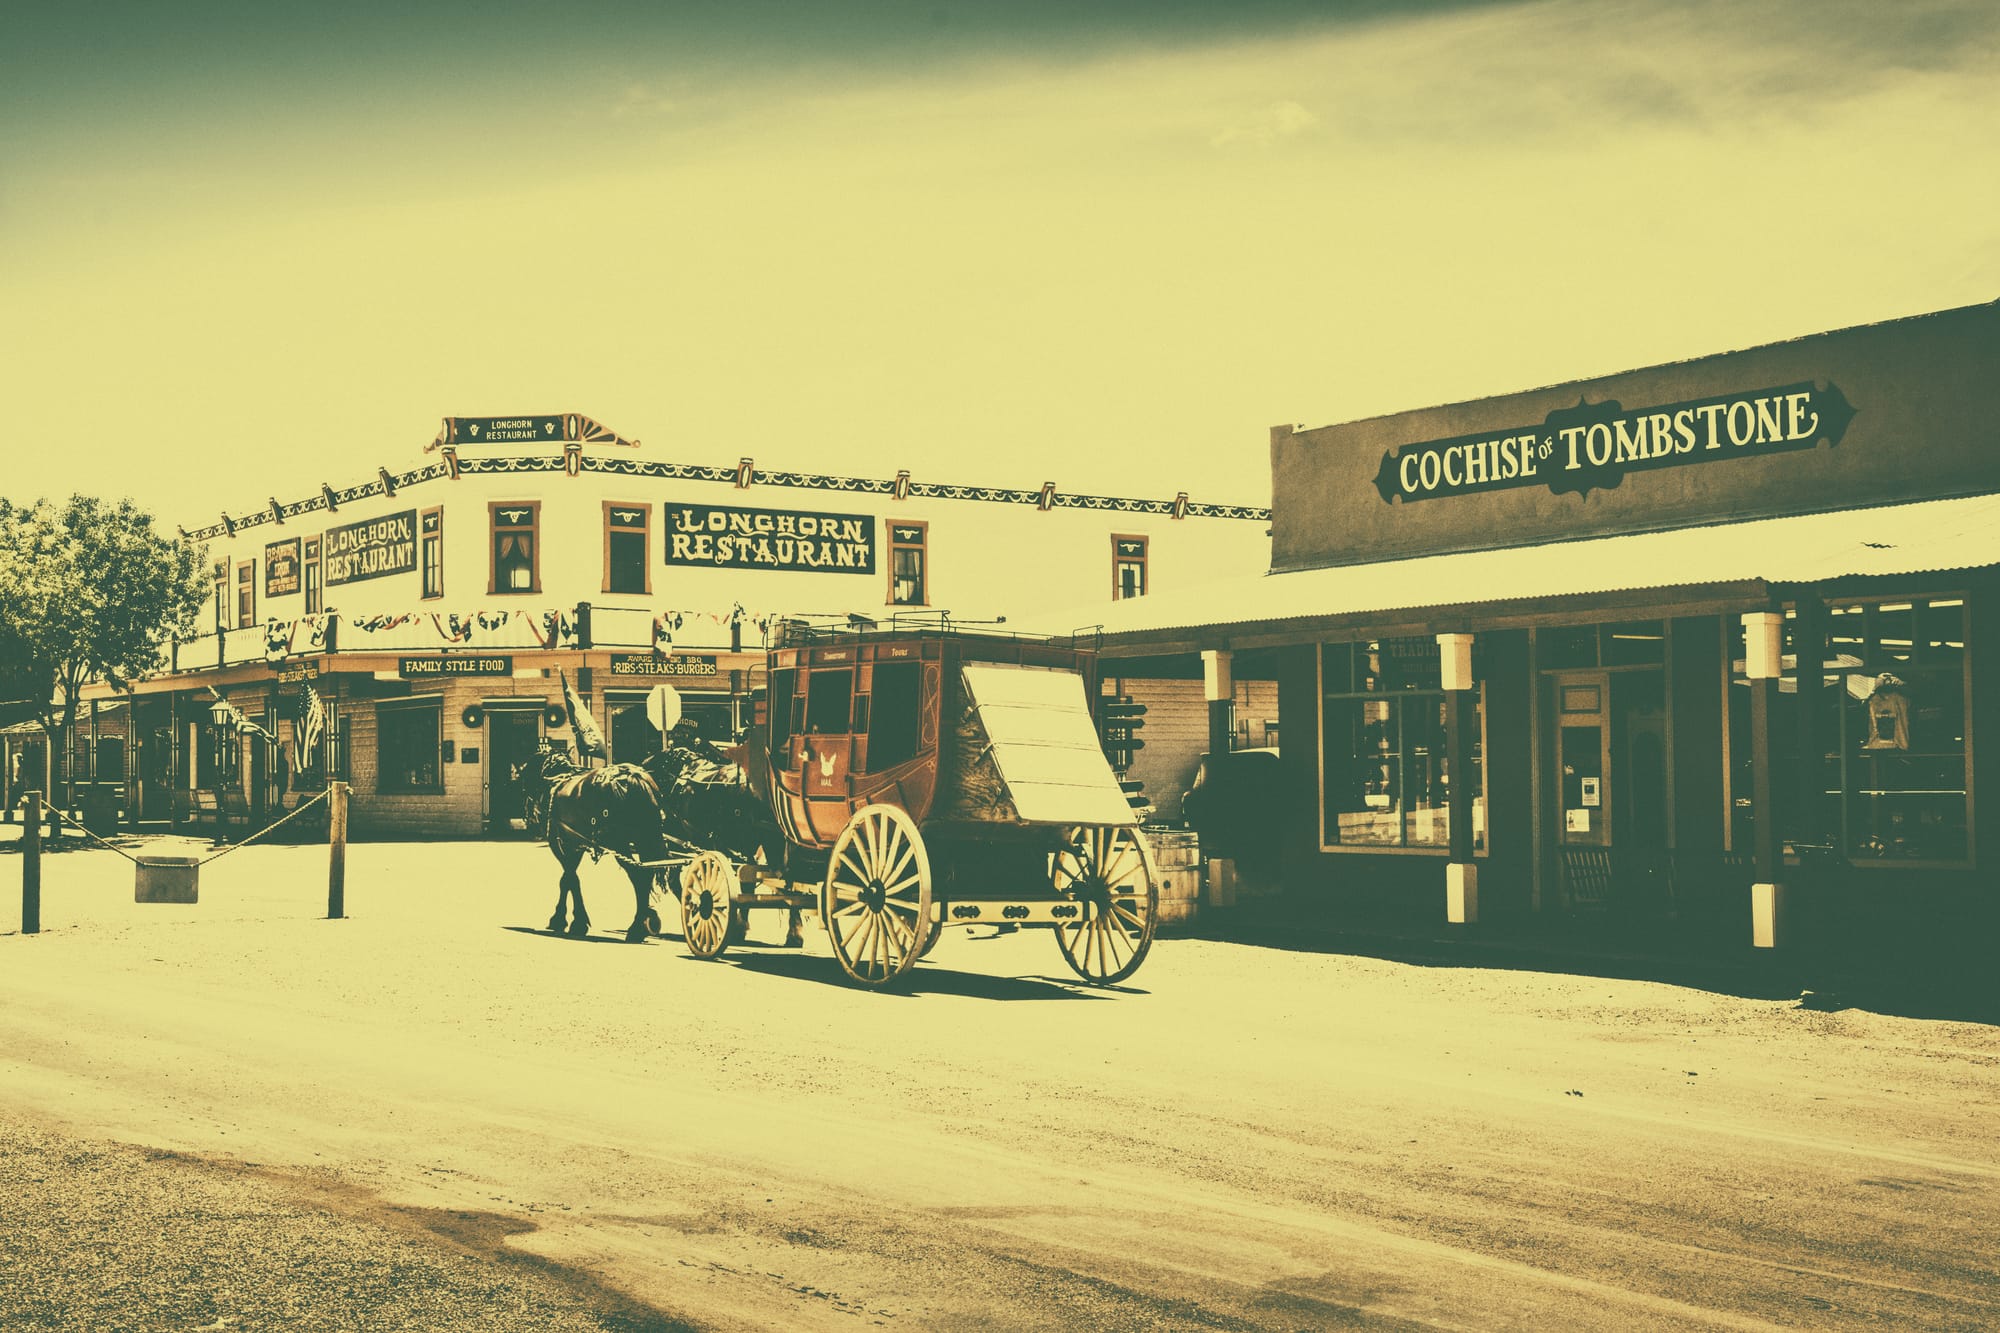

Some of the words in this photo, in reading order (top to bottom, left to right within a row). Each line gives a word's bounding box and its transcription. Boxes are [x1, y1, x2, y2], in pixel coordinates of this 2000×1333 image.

[486, 430, 537, 440] RESTAURANT
[491, 420, 532, 430] LONGHORN
[1400, 435, 1537, 493] COCHISE
[1538, 436, 1553, 460] OF
[1559, 392, 1819, 470] TOMBSTONE
[328, 517, 411, 556] LONGHORN
[676, 509, 867, 544] LONGHORN
[327, 542, 413, 581] RESTAURANT
[671, 534, 869, 567] RESTAURANT
[686, 656, 702, 664] BBQ
[1390, 644, 1440, 657] TRADIN
[405, 661, 442, 672] FAMILY
[446, 660, 476, 671] STYLE
[480, 660, 505, 671] FOOD
